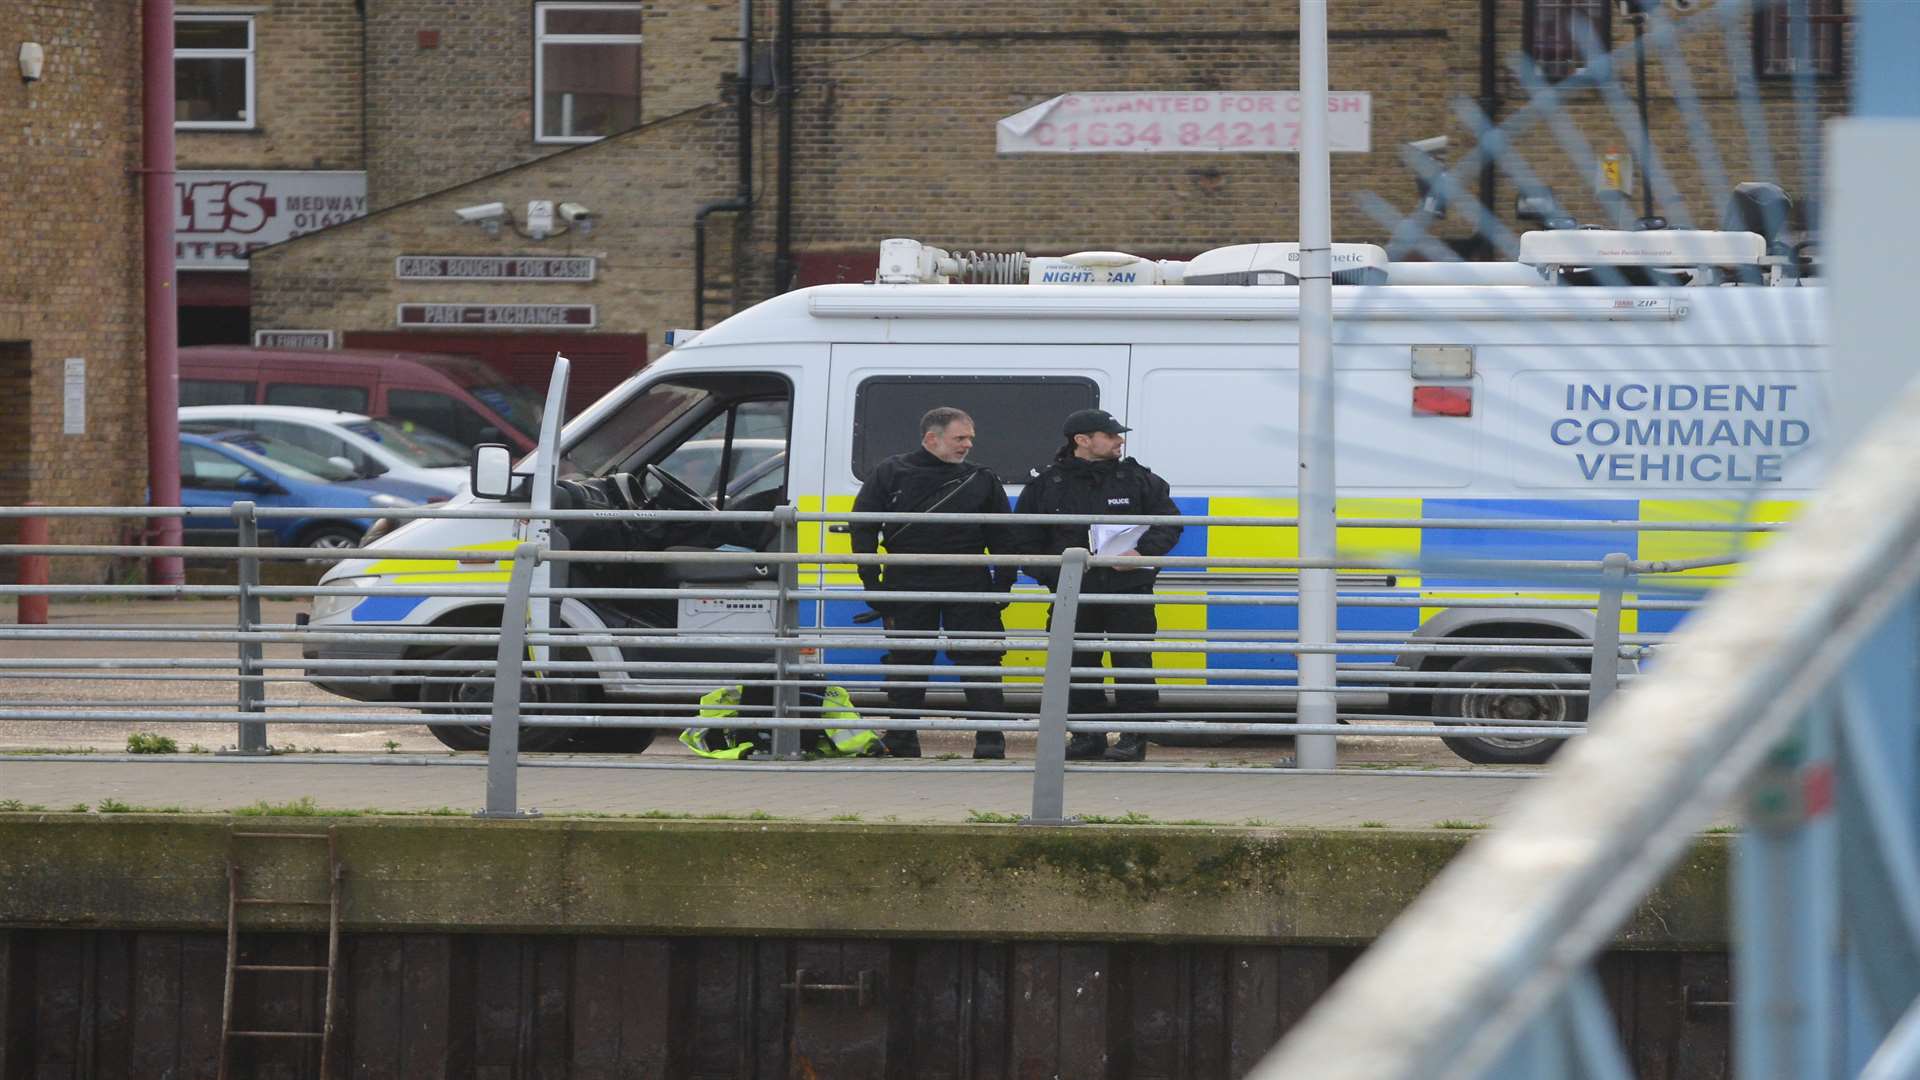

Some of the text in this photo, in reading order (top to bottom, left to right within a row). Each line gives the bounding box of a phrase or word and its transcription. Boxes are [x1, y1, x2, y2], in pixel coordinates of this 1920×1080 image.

[1219, 96, 1276, 113] FOR
[1284, 96, 1362, 113] CSH
[1037, 121, 1162, 146] 01634
[286, 196, 367, 211] MEDWAY
[295, 213, 360, 230] 0163
[401, 259, 589, 278] CARS BOUGHT FOR CASH
[1042, 271, 1137, 283] NIGHTAN
[1637, 299, 1658, 307] ZIP
[1566, 383, 1798, 411] INCIDENT
[1550, 418, 1811, 447] COMMAND
[1575, 453, 1783, 482] VEHICLE
